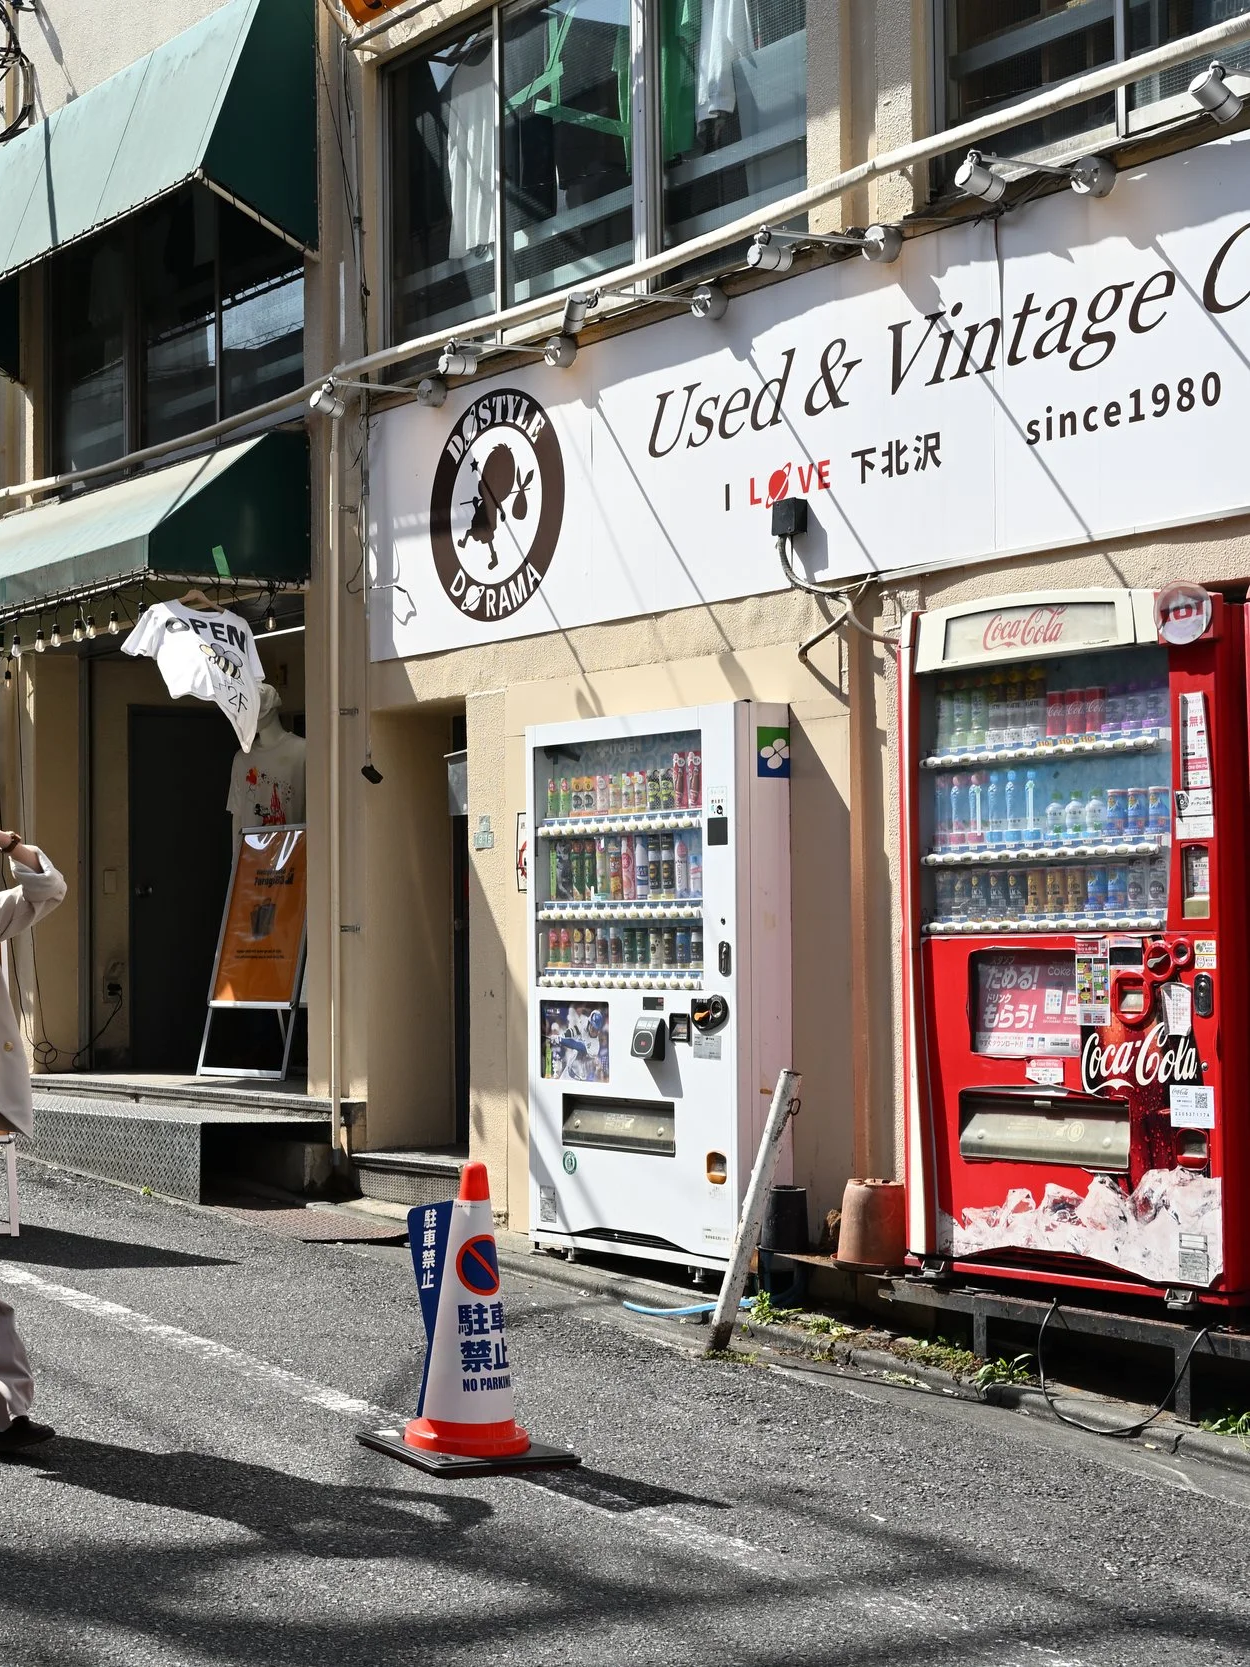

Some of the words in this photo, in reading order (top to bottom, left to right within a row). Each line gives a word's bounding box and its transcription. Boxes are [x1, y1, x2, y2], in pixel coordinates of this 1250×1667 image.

[649, 347, 797, 458] Used
[804, 338, 862, 416] &
[887, 269, 1177, 396] Vintage
[1026, 371, 1222, 446] since1980
[851, 432, 943, 485] 下北沢
[165, 617, 246, 655] OPEN
[983, 604, 1068, 651] Coca-Cola
[227, 685, 250, 713] 2F
[984, 1004, 1038, 1029] もらう!
[987, 993, 1012, 1004] ドリンク
[1082, 1022, 1197, 1094] Coca-Cola
[421, 1209, 437, 1290] 駐車禁止
[457, 1302, 507, 1337] 駐車
[461, 1338, 510, 1373] 禁止
[462, 1378, 478, 1393] NO
[480, 1374, 511, 1392] PARKIN
